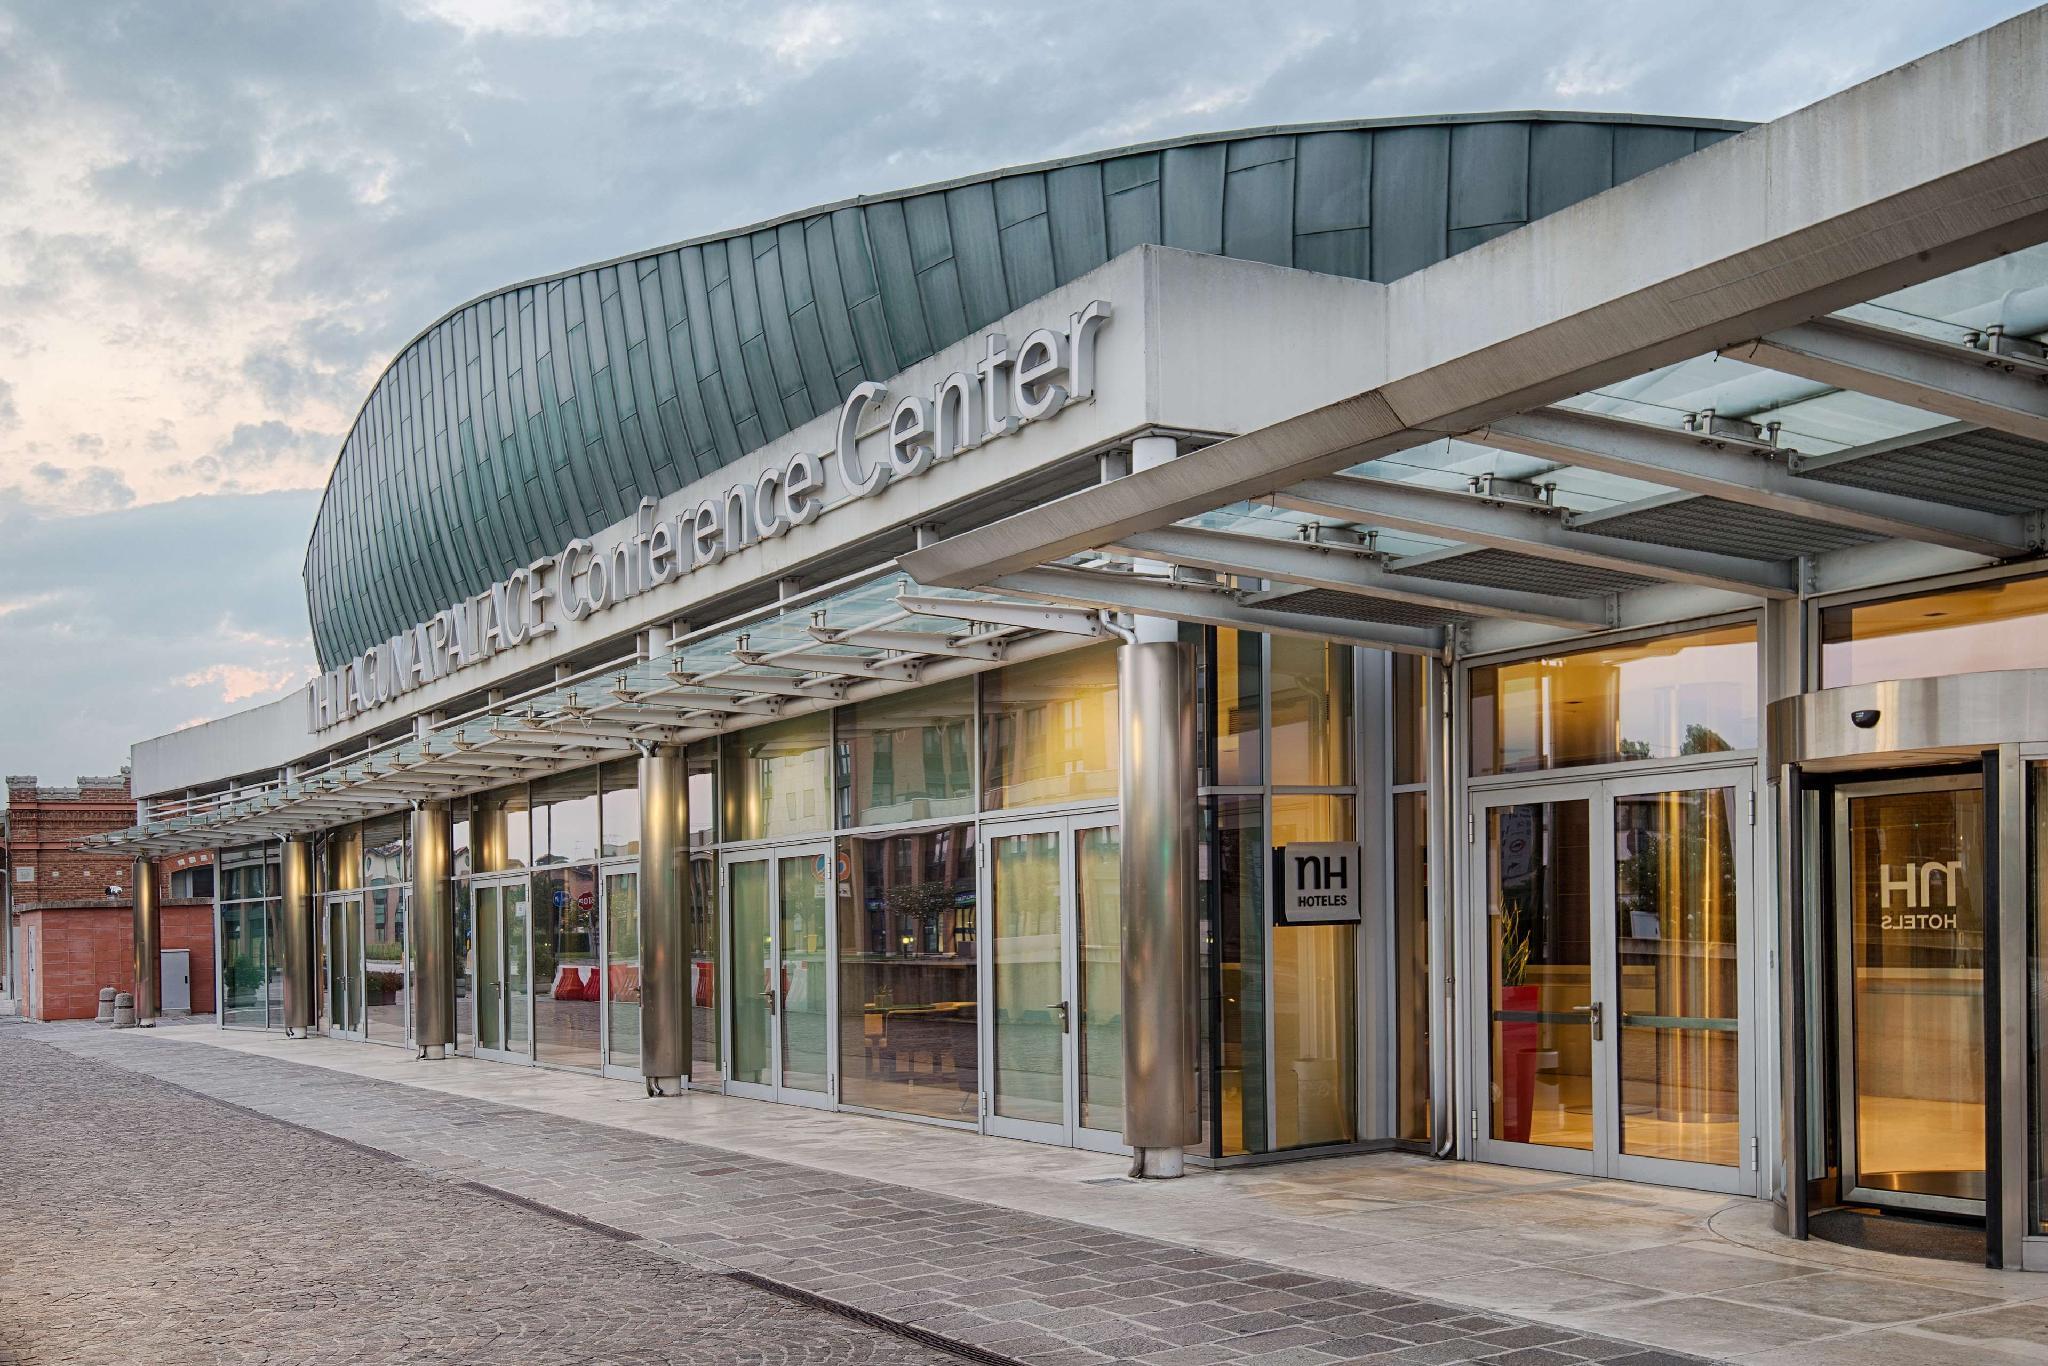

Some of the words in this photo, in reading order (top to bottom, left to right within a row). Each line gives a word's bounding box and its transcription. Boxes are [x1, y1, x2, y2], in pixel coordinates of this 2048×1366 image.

[337, 623, 434, 720] LAGUNA
[434, 556, 556, 679] PALACE
[560, 452, 824, 621] Conference
[836, 300, 1111, 497] Center
[1298, 895, 1347, 908] HOTELES
